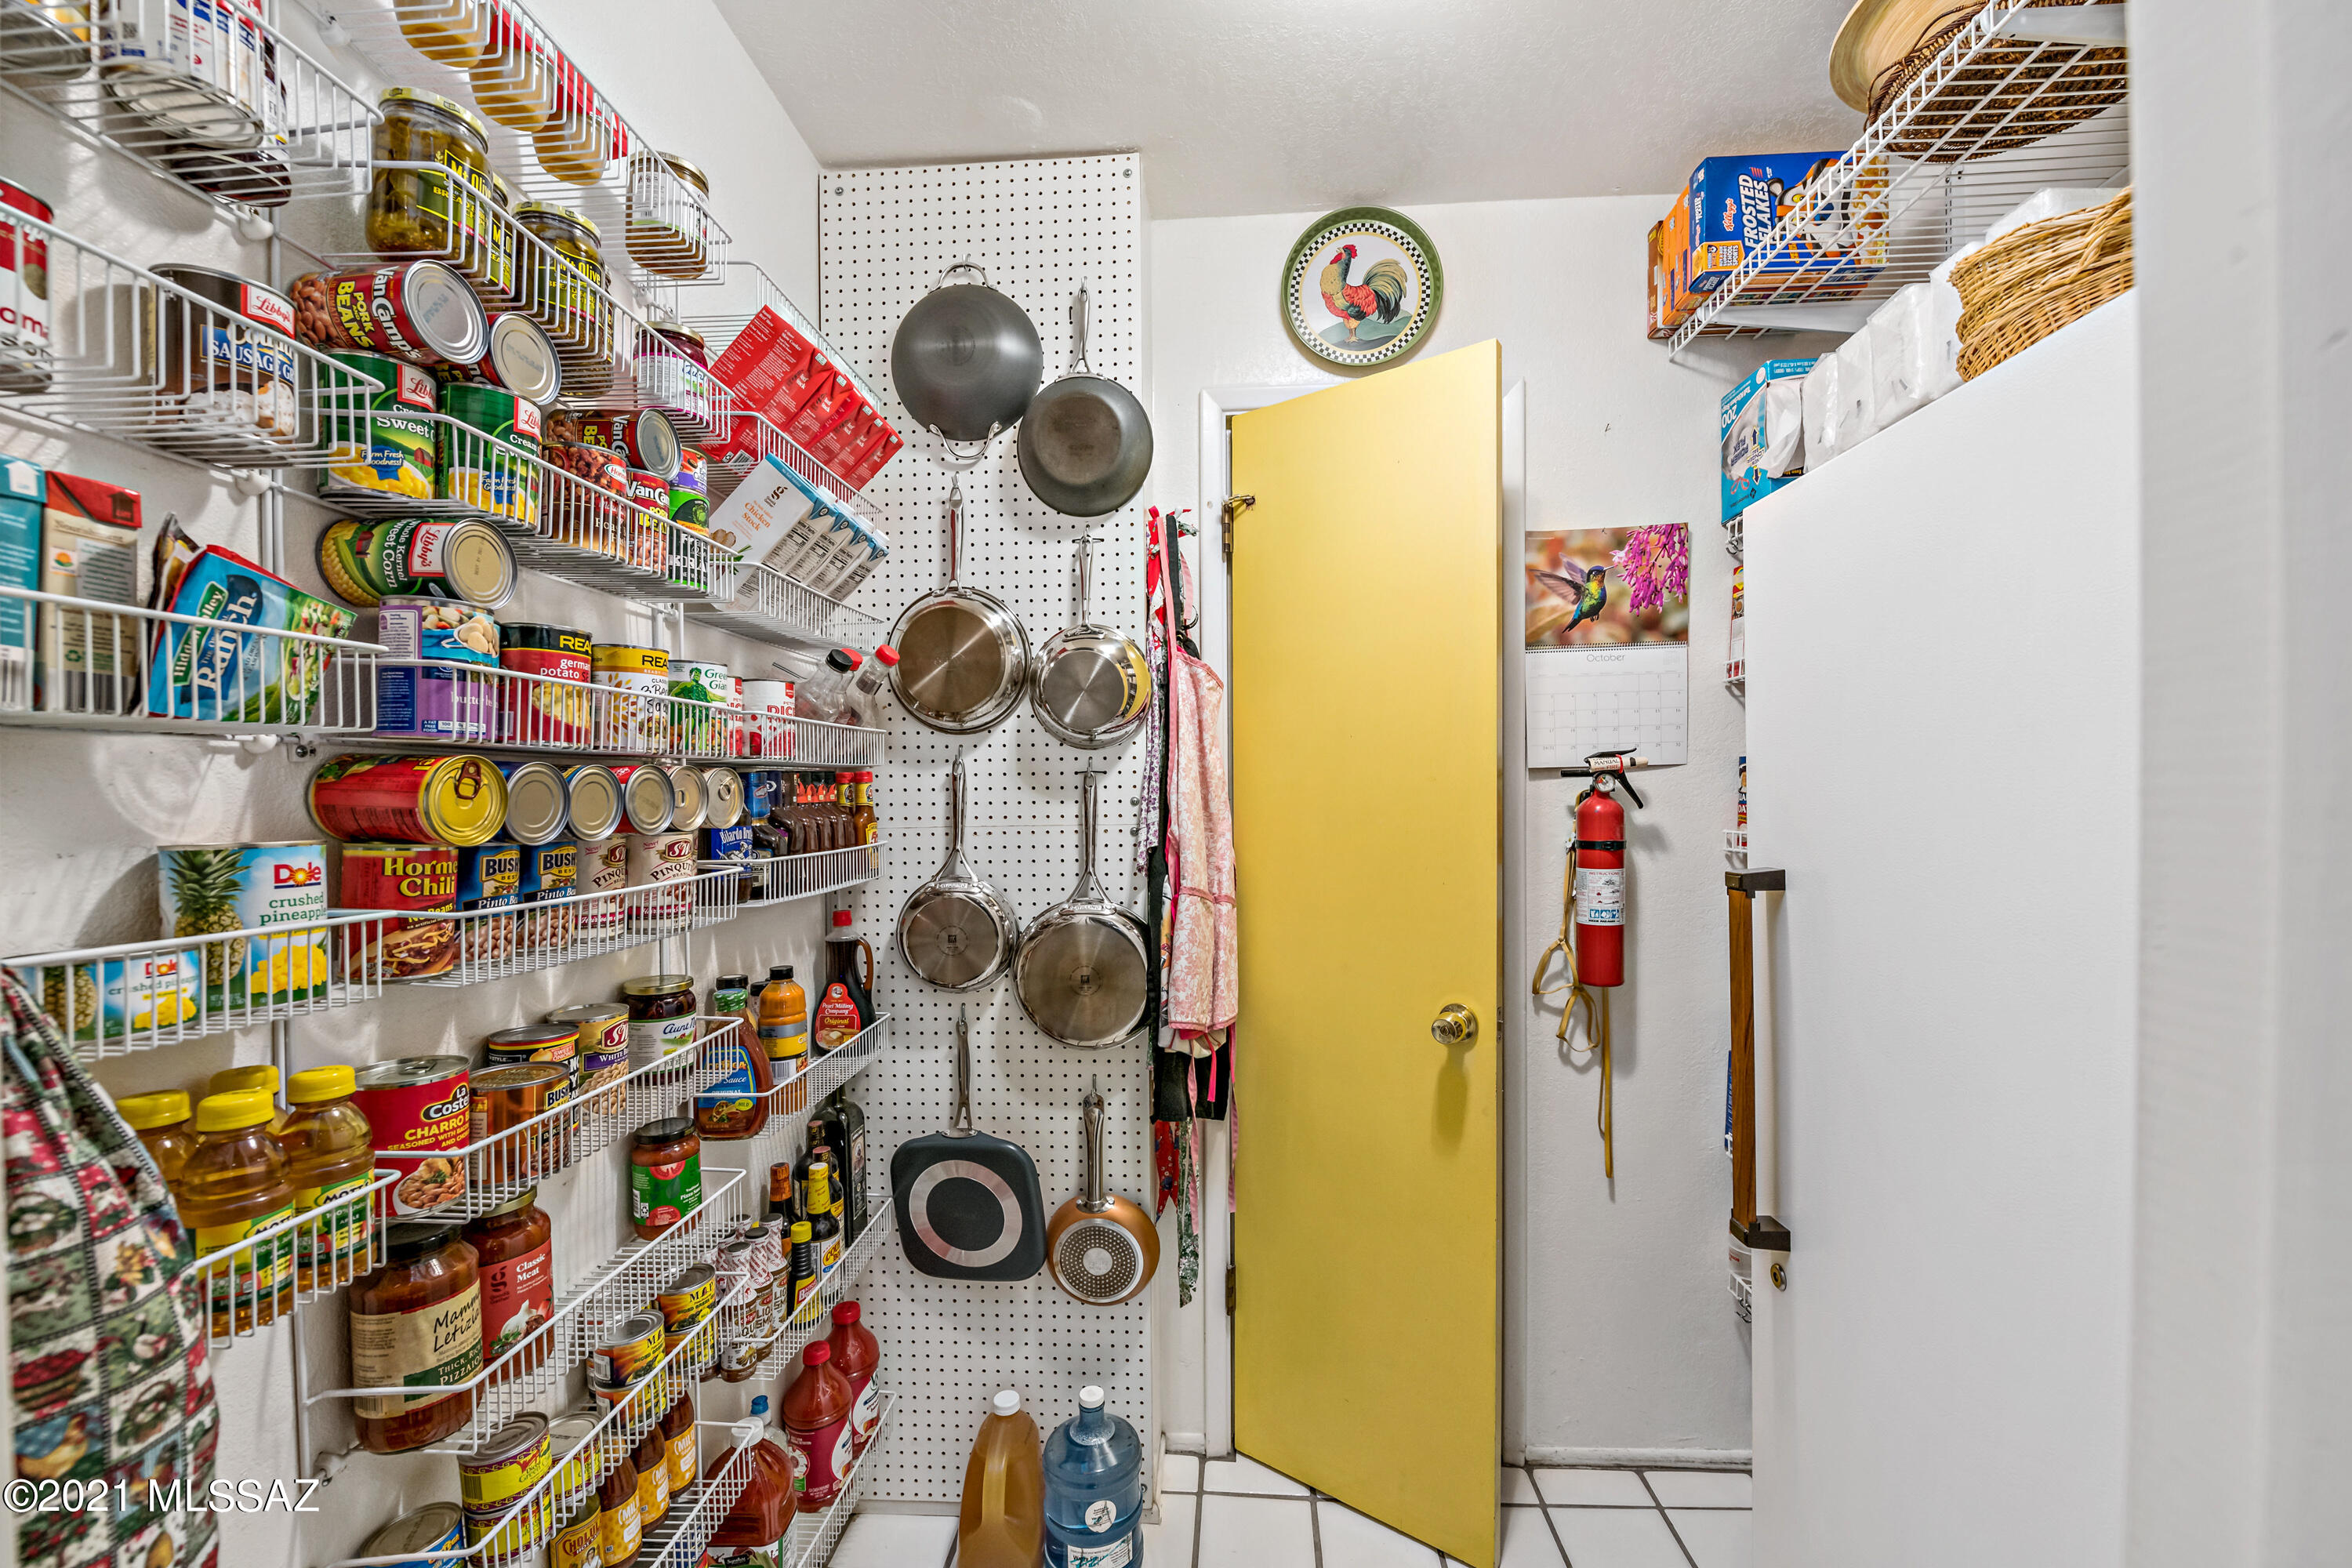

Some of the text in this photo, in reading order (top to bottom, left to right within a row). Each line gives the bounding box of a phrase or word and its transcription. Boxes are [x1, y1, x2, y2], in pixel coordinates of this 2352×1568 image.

[1722, 198, 1737, 232] Kellogg's
[1738, 173, 1759, 249] FROSTED
[252, 296, 292, 323] Libby's
[336, 281, 376, 348] BEANS
[353, 292, 376, 332] PORK
[1731, 444, 1749, 467] POWER
[742, 512, 760, 532] Stock
[744, 503, 771, 528] Chicken
[417, 527, 440, 568] Libby's
[383, 550, 398, 588] Corn
[396, 545, 408, 581] Kernel
[540, 667, 579, 679] potato
[719, 828, 742, 843] Bilardo
[274, 862, 322, 884] Dole
[399, 877, 454, 897] Chili
[536, 889, 565, 901] Pinto
[269, 891, 324, 909] crushed
[477, 897, 507, 909] Pinto
[834, 1002, 854, 1011] Milling
[662, 1022, 690, 1035] Aunt
[553, 1051, 574, 1062] ONIONS
[554, 1045, 572, 1055] SWEET
[599, 1051, 622, 1063] WHITE
[456, 1087, 466, 1098] La
[405, 1115, 464, 1141] CHARRO
[387, 1131, 456, 1151] SEASONED WITH
[441, 1138, 456, 1147] AND
[516, 1253, 546, 1273] Classic
[517, 1266, 539, 1283] Meat
